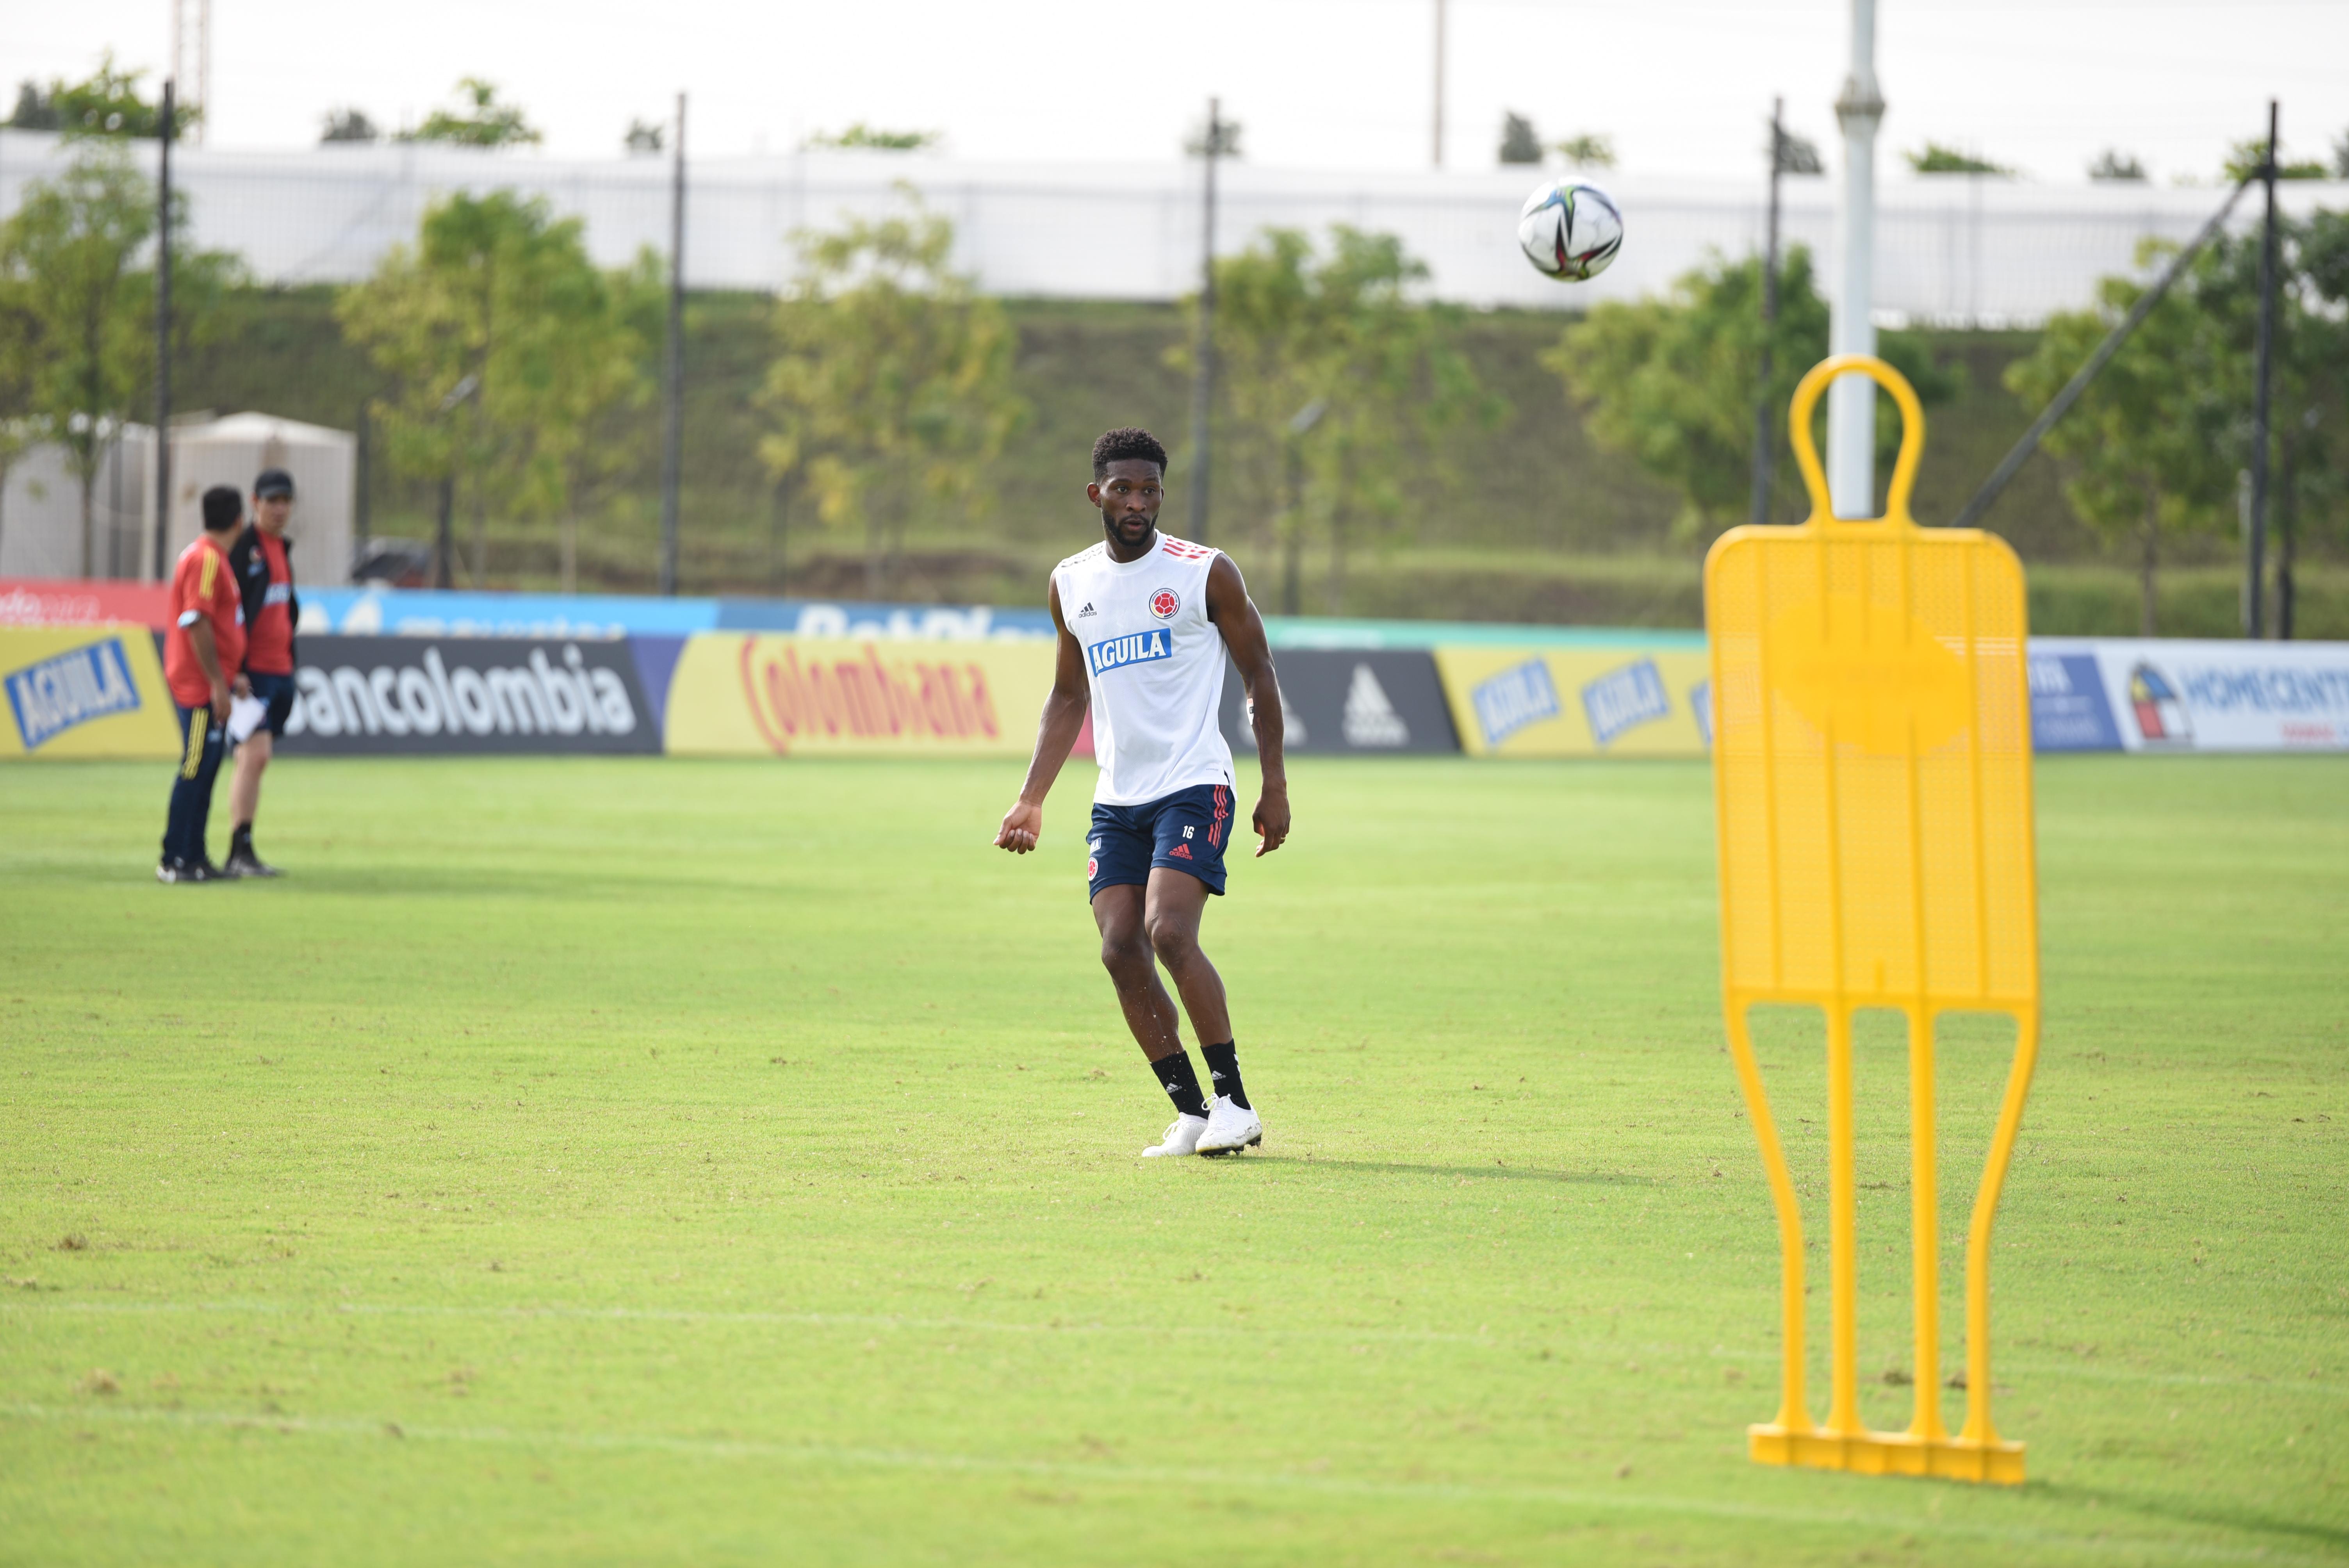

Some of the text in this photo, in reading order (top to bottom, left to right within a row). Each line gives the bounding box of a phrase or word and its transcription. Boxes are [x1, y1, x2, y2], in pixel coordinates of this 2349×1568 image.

[1093, 632, 1167, 674] AGUILA
[15, 642, 135, 744] AGUILA
[2178, 665, 2349, 713] HOMECENT
[1183, 825, 1194, 839] 16
[1169, 851, 1193, 860] adidas
